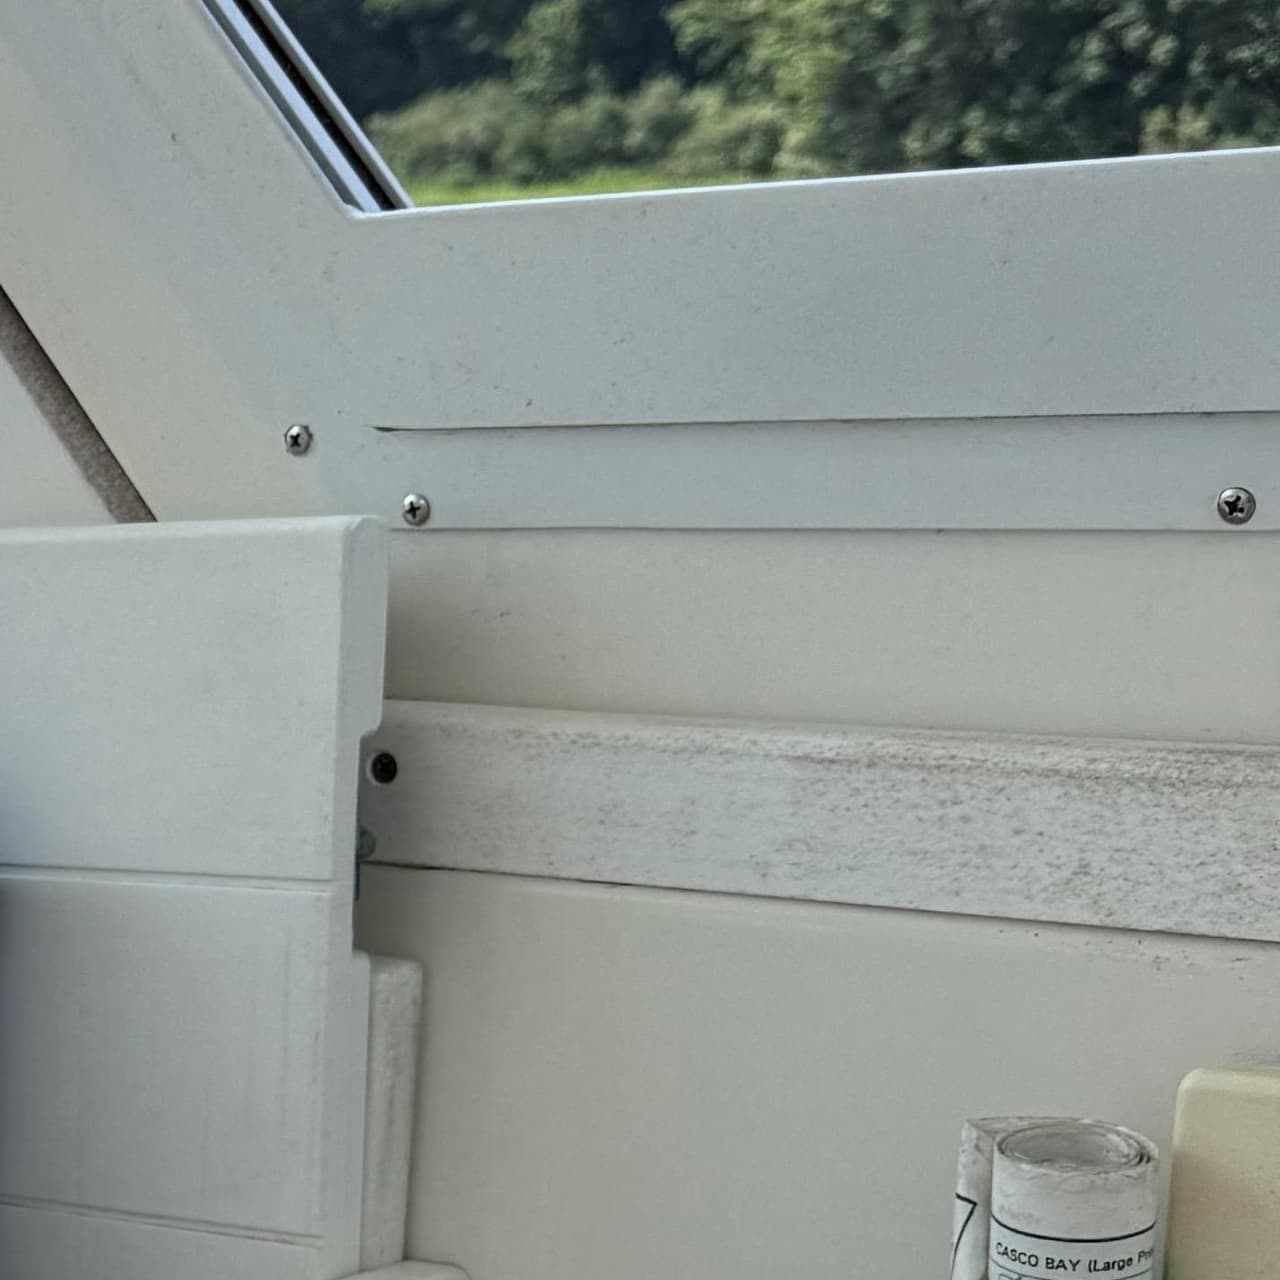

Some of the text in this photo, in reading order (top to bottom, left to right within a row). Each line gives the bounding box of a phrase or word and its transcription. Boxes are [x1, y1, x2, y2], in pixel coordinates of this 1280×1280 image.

[995, 1241, 1039, 1268] CASCO
[1045, 1257, 1081, 1273] BAY
[1088, 1256, 1134, 1274] (Large
